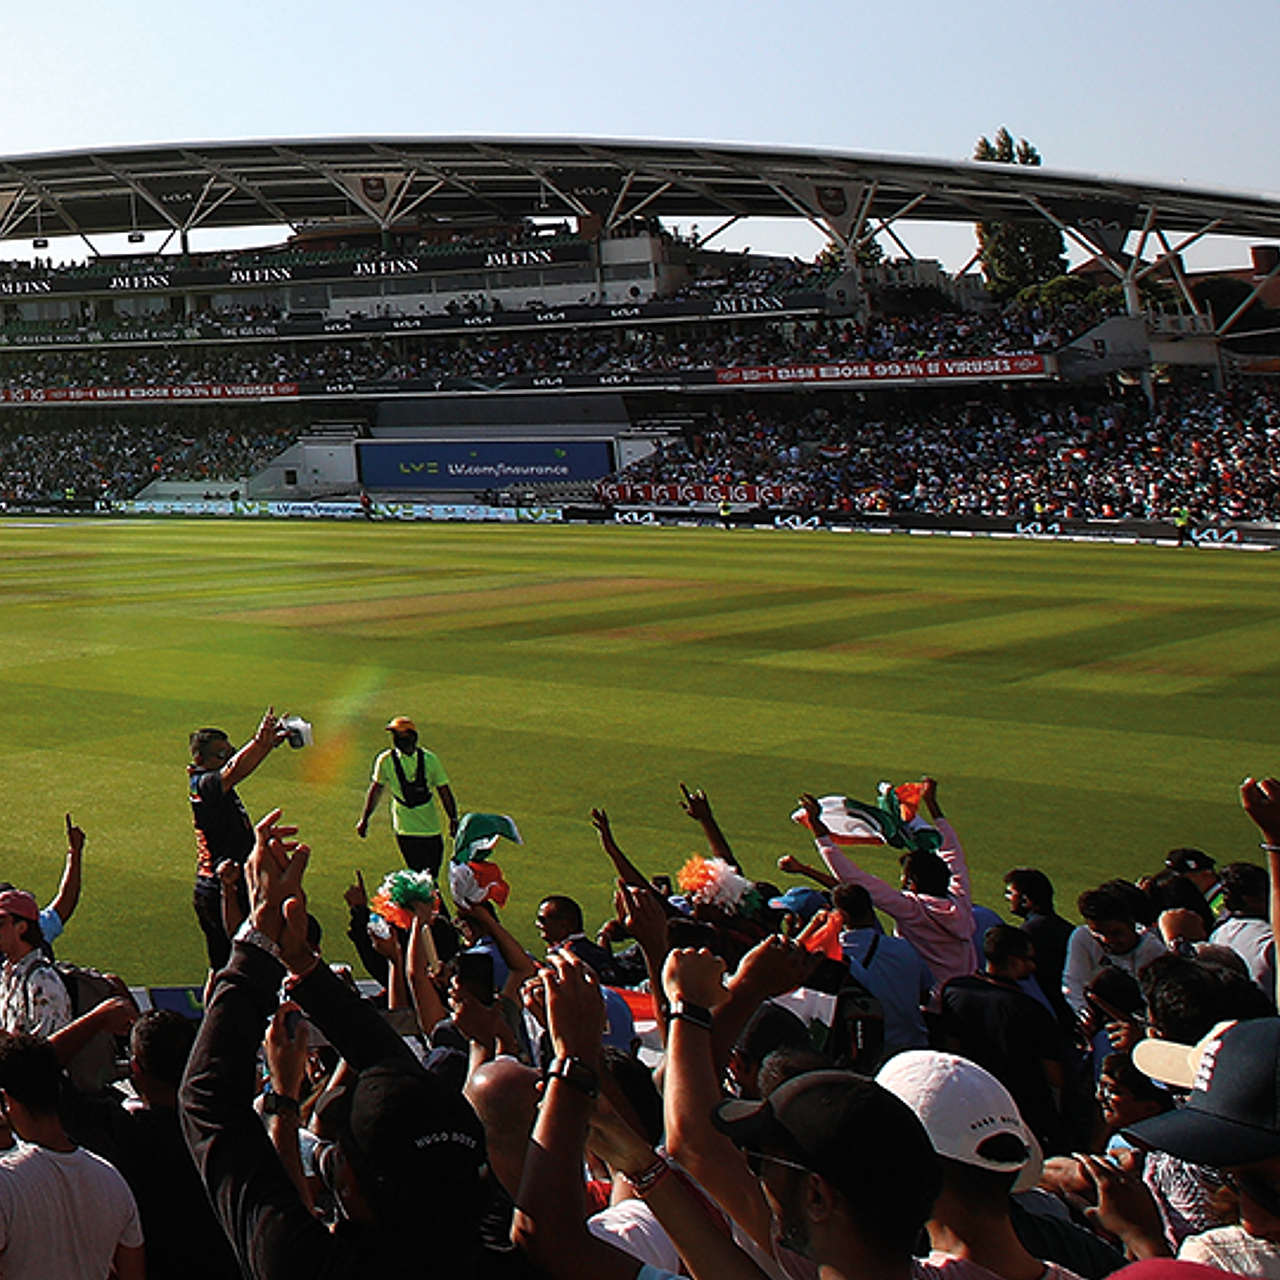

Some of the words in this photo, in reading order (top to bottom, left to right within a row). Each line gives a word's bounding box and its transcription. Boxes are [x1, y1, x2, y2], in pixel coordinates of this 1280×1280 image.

[484, 253, 506, 266] JM
[512, 249, 553, 264] FINN
[354, 262, 376, 275] JM
[381, 259, 418, 273] FINN
[110, 276, 130, 288] JM
[134, 275, 170, 288] FINN
[230, 270, 251, 283] JM
[255, 268, 292, 281] FINN
[16, 281, 51, 293] FINN
[713, 300, 736, 313] JM
[741, 296, 784, 311] FINN
[614, 512, 655, 524] KIA
[774, 514, 821, 529] KIA
[1191, 528, 1242, 543] KIA
[415, 1131, 449, 1148] HUGO
